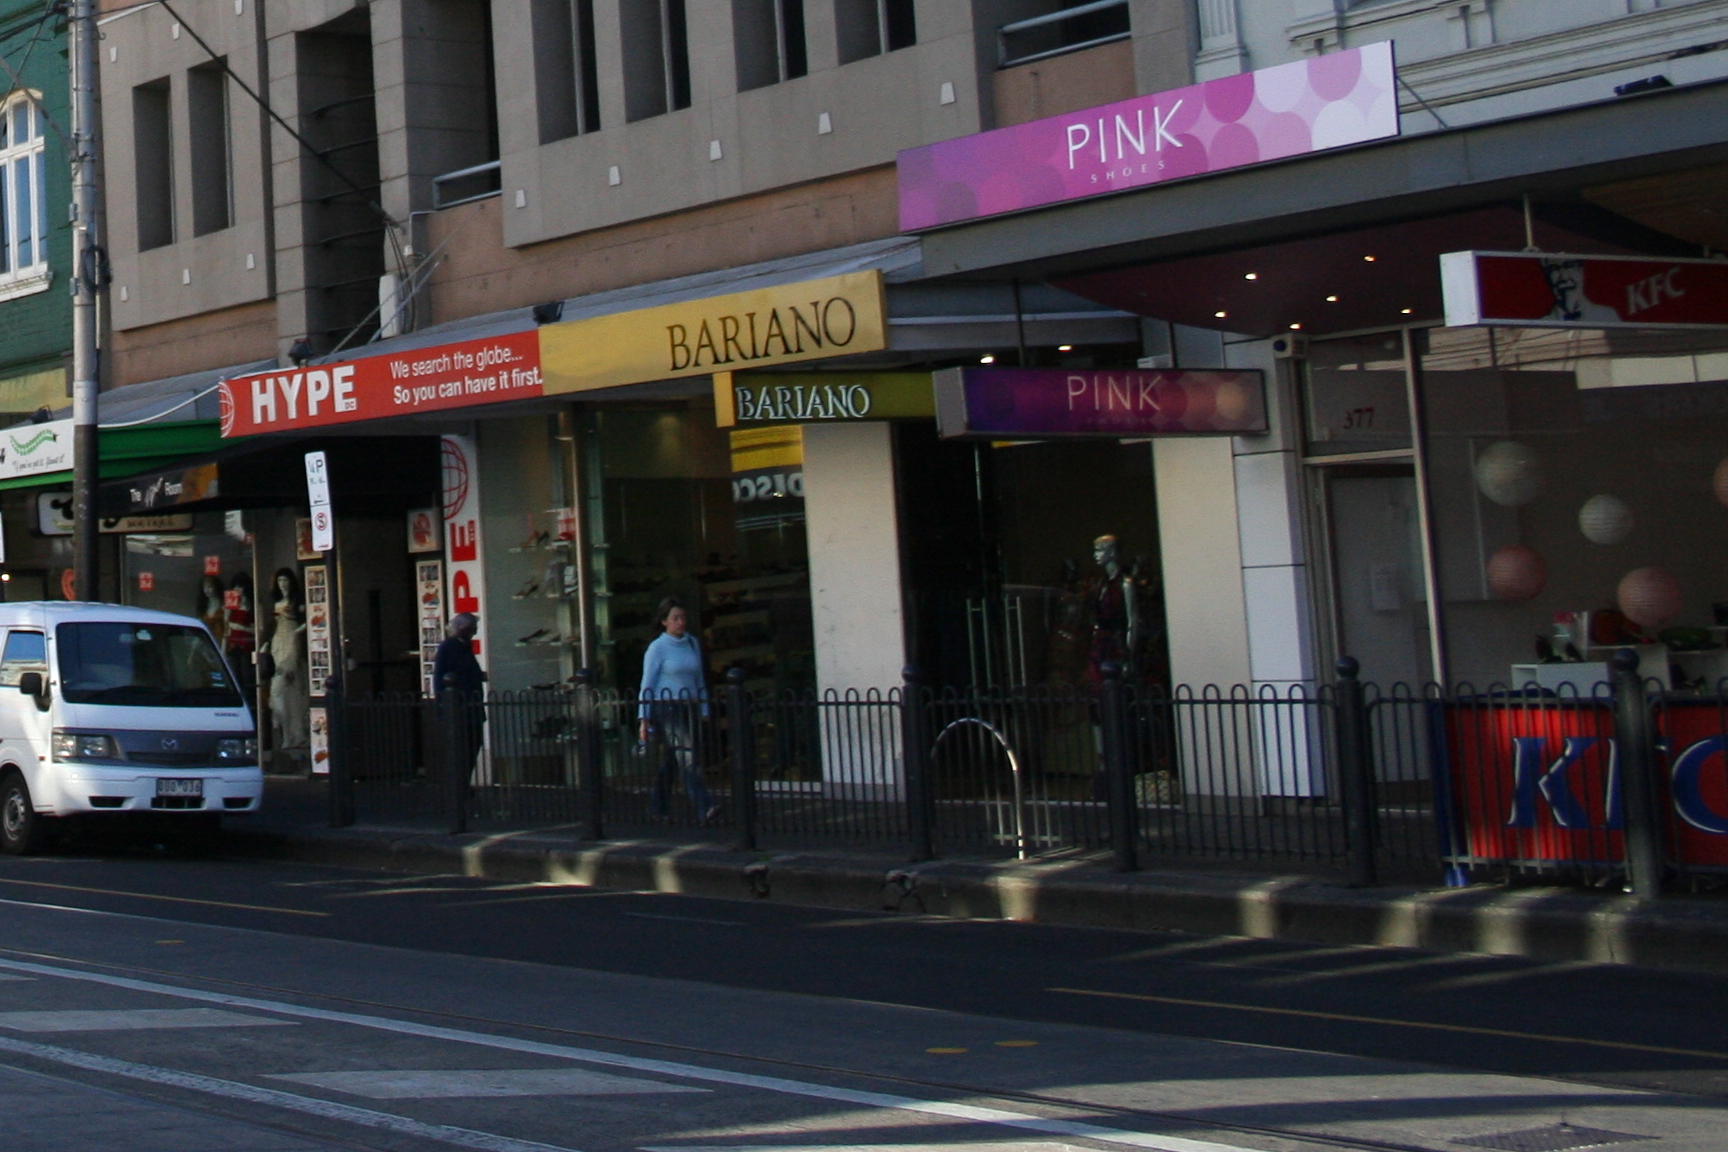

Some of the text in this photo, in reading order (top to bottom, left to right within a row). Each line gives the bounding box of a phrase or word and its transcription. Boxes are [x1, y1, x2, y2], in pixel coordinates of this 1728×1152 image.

[1066, 99, 1183, 169] PINK
[1090, 160, 1165, 184] SHOES
[1626, 266, 1685, 316] KFC
[666, 297, 856, 371] BARIANO
[390, 359, 410, 379] We
[411, 352, 450, 377] search
[453, 350, 473, 369] the
[252, 365, 356, 424] HYPE
[393, 366, 544, 406] So you can have it first.
[735, 385, 870, 420] BARIANO
[1066, 375, 1162, 411] PINK
[130, 488, 142, 503] The
[164, 482, 182, 496] Room
